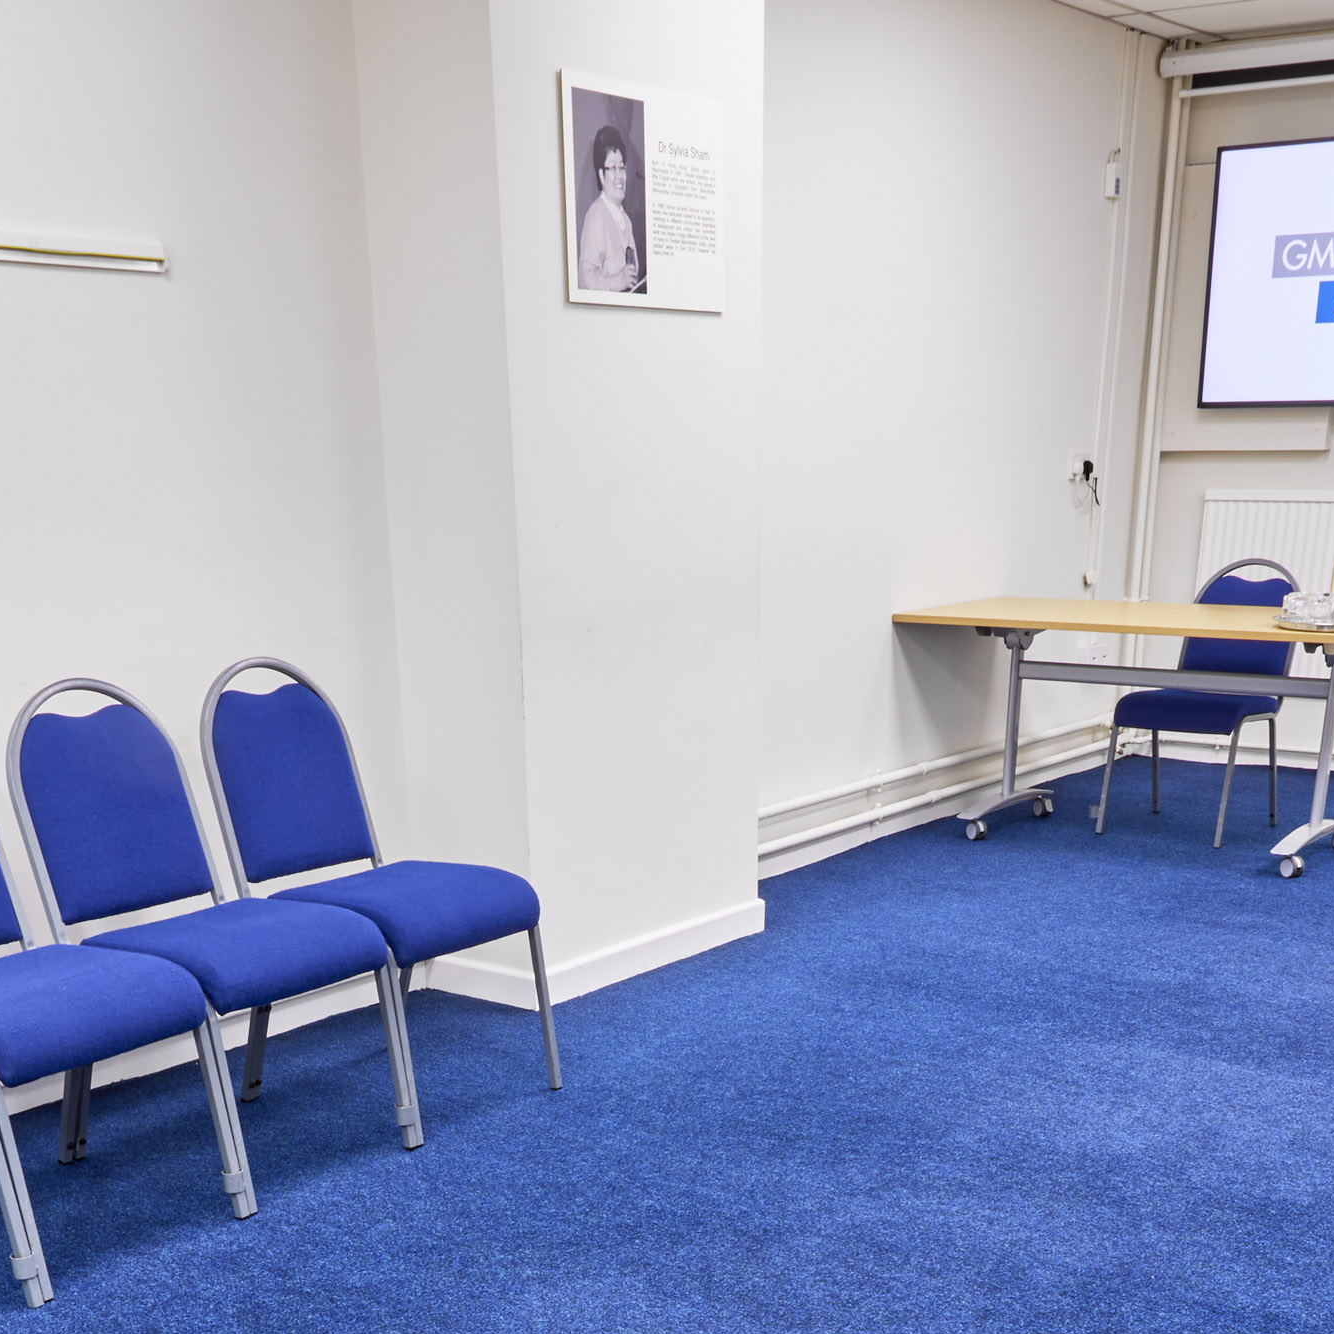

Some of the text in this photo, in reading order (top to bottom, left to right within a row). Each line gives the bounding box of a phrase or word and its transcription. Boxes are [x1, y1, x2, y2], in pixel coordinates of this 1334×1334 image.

[658, 140, 710, 161] Dr Sylvia Sham
